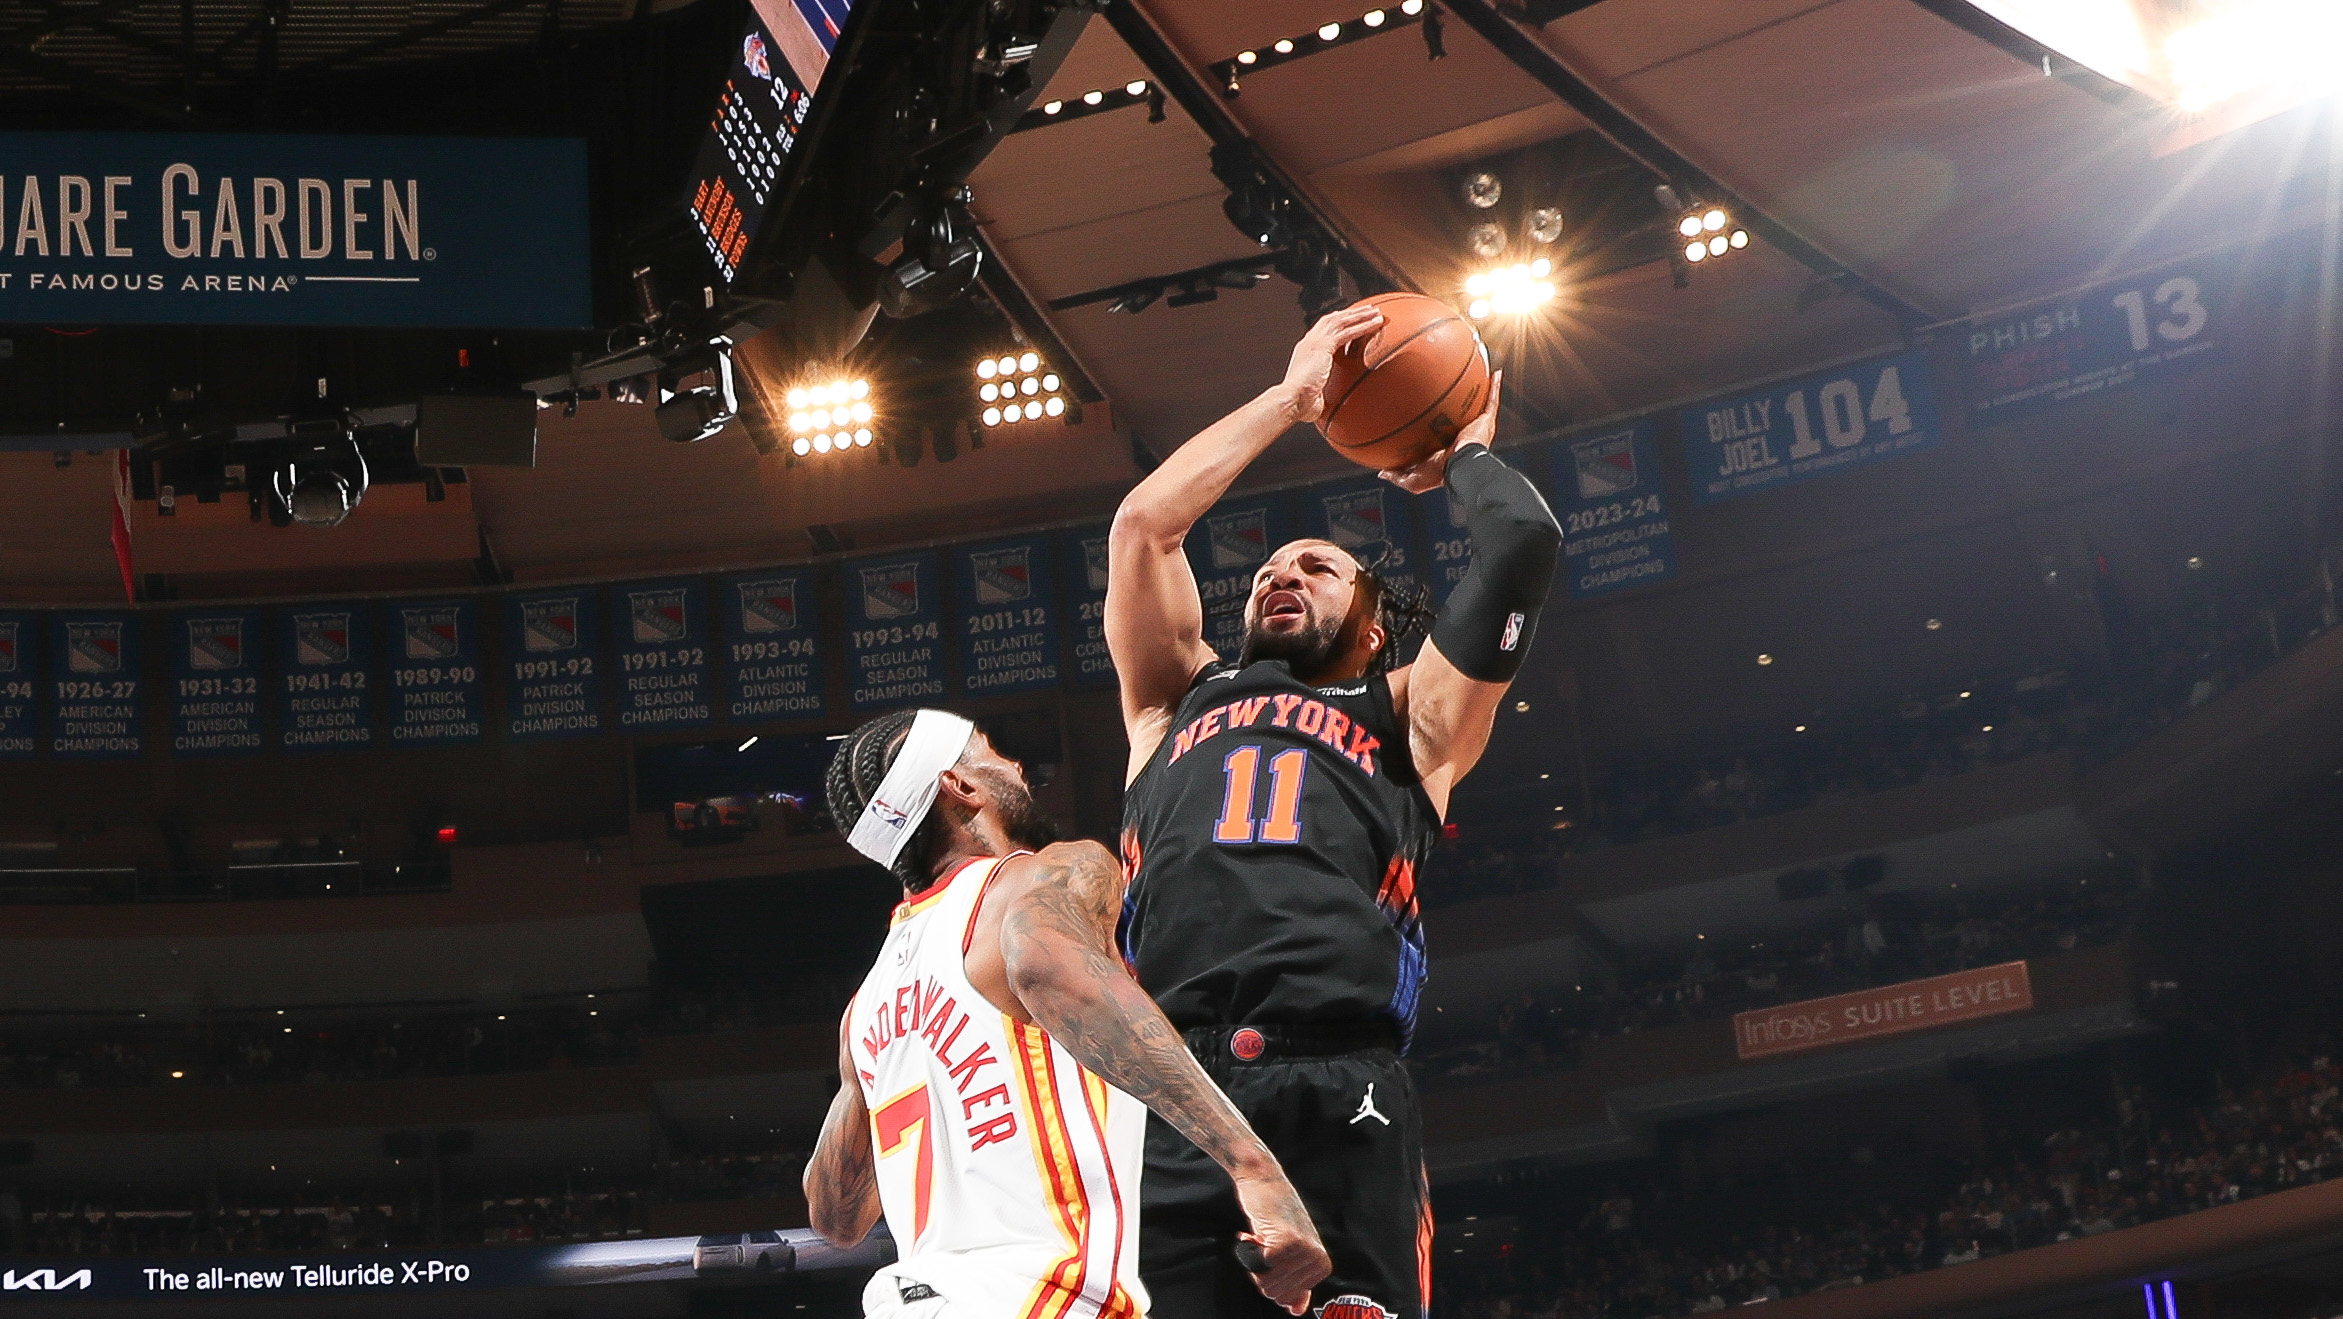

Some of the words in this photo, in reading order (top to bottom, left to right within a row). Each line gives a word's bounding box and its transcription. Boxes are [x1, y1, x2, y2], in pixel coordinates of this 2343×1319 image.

[770, 77, 789, 110] 12
[30, 273, 165, 291] FAMOUS
[2112, 276, 2207, 352] 13
[1969, 306, 2081, 355] PHISH
[1706, 400, 1771, 443] BILLY
[1784, 366, 1913, 460] 104
[1718, 435, 1779, 476] JOEL
[1567, 494, 1661, 534] 2023-24
[1565, 522, 1669, 556] METROPOLITAN
[1589, 544, 1650, 569] DIVISION
[1579, 559, 1665, 591] CHAMPIONS
[968, 608, 1045, 634] 2011-12
[853, 622, 939, 648] 1993-94
[973, 633, 1045, 654] ATLANTIC
[622, 648, 704, 672] 1991-92
[732, 638, 815, 662] 1993-94
[860, 648, 931, 668] REGULAR
[515, 657, 593, 680] 1991-92
[978, 651, 1042, 671] DIVISION
[287, 672, 366, 691] 1941-42
[395, 666, 475, 686] 1989-90
[628, 673, 698, 692] REGULAR
[738, 663, 809, 682] ATLANTIC
[866, 666, 927, 685] SEASON
[967, 665, 1056, 689] CHAMPIONS
[57, 681, 136, 699] 1926-27
[179, 678, 257, 697] 1931-32
[523, 682, 584, 699] PATRICK
[742, 682, 807, 698] DIVISION
[855, 680, 943, 703] CHAMPIONS
[291, 696, 360, 711] REGULAR
[404, 691, 464, 706] PATRICK
[523, 700, 585, 716] DIVISION
[634, 691, 694, 708] SEASON
[732, 696, 821, 716] CHAMPIONS
[59, 706, 133, 718] AMERICAN
[180, 702, 254, 716] AMERICAN
[405, 707, 466, 722] DIVISION
[621, 706, 709, 725] CHAMPIONS
[66, 722, 126, 734] DIVISION
[187, 718, 248, 732] DIVISION
[297, 713, 356, 727] SEASON
[512, 714, 598, 734] CHAMPIONS
[284, 728, 370, 745] CHAMPIONS
[393, 722, 479, 739] CHAMPIONS
[54, 738, 139, 751] CHAMPIONS
[175, 733, 261, 750] CHAMPIONS
[1212, 745, 1311, 844] 11
[1744, 1010, 1833, 1045] Infosys
[1842, 994, 1925, 1028] SUITE
[1932, 979, 2021, 1012] LEVEL
[869, 1080, 937, 1257] 7
[143, 1267, 190, 1291] The
[196, 1266, 284, 1290] all-new
[290, 1261, 394, 1289] Telluride
[401, 1260, 470, 1284] X-Pro
